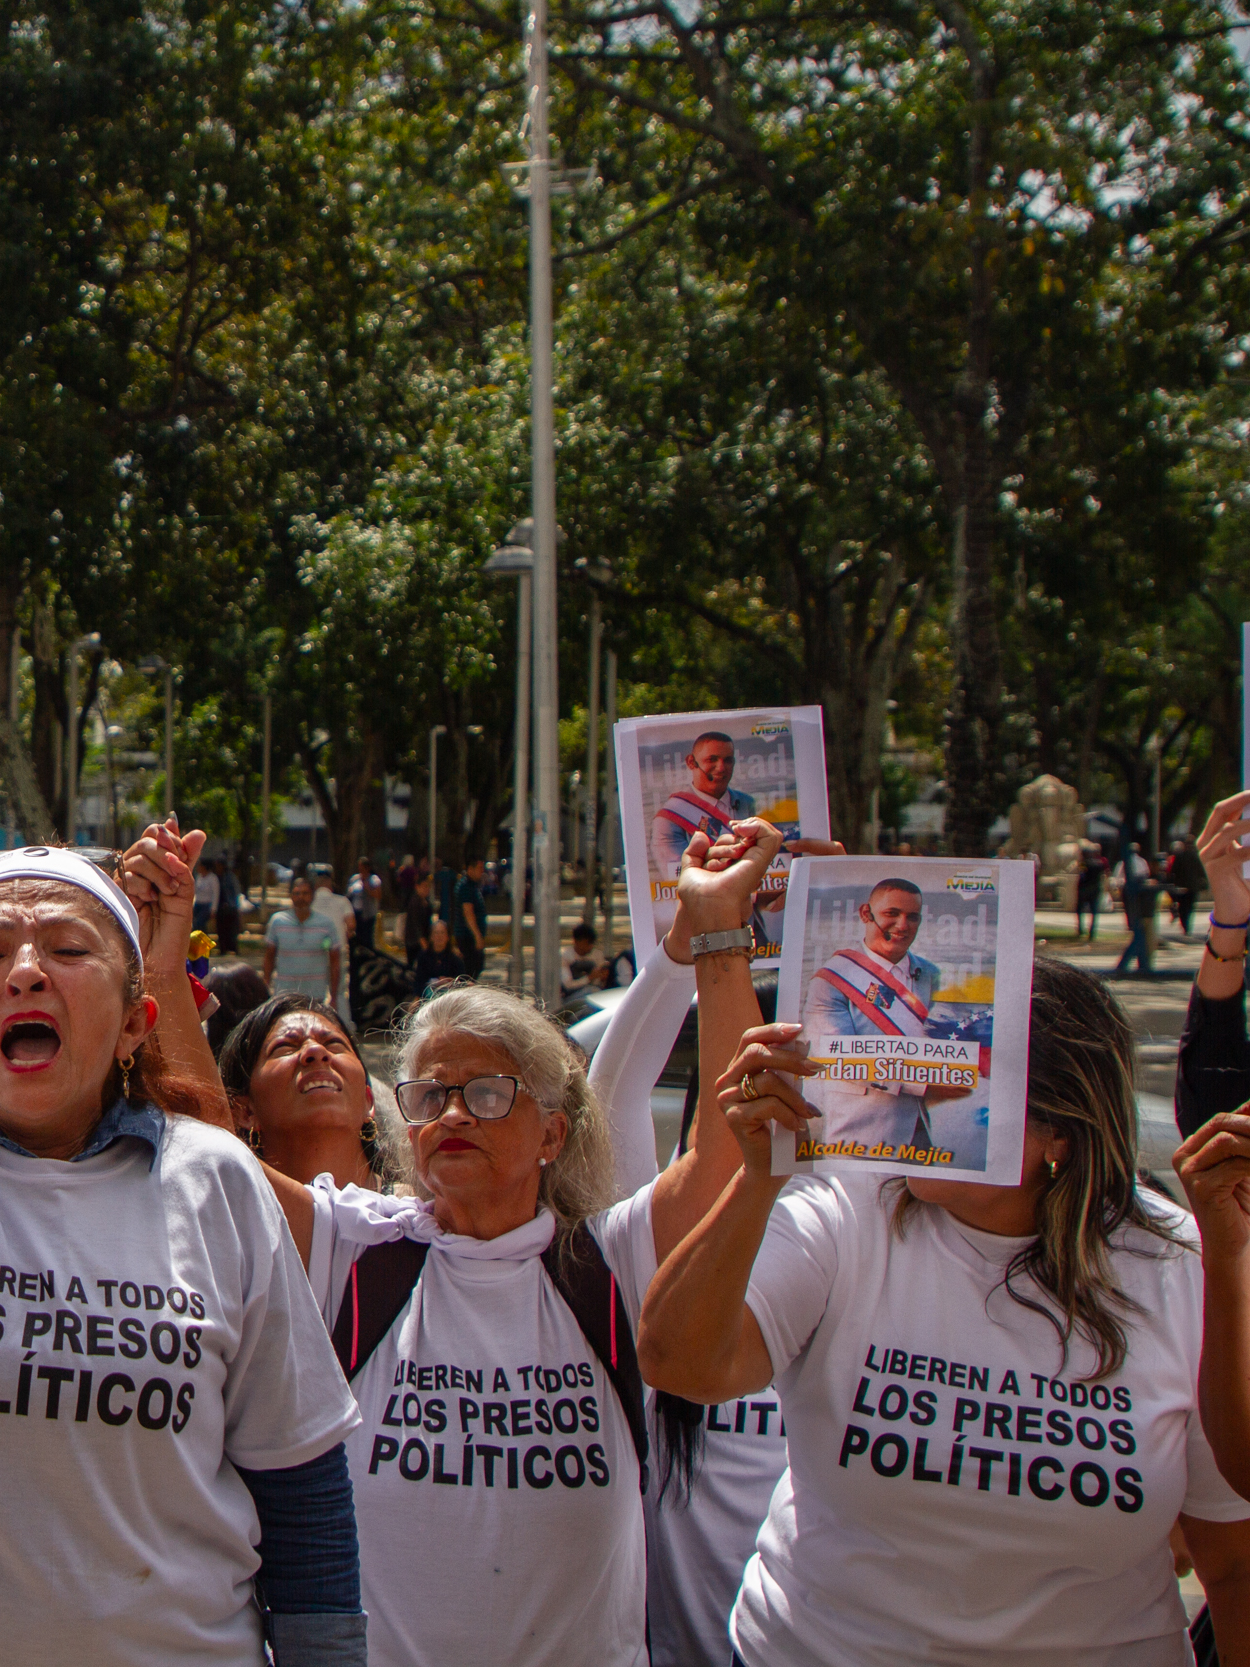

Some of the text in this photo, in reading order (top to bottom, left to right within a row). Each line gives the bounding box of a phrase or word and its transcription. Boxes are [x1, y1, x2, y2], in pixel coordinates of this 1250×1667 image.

[799, 1057, 975, 1087] rdan Sifuentes
[829, 1040, 969, 1060] #LIBERTAD PARA
[796, 1139, 953, 1165] Alcalde de Mejía
[65, 1275, 89, 1305] A
[96, 1279, 206, 1320] TODOS
[21, 1308, 203, 1370] PRESOS
[394, 1359, 594, 1393] LIBEREN A TODOS
[864, 1343, 1132, 1412] LIBEREN A TODOS
[381, 1392, 600, 1436] LOS PRESOS
[852, 1375, 938, 1426] LOS
[953, 1397, 1137, 1455] PRESOS
[368, 1433, 610, 1489] POLÍTICOS
[838, 1423, 1145, 1513] POLÍTICOS
